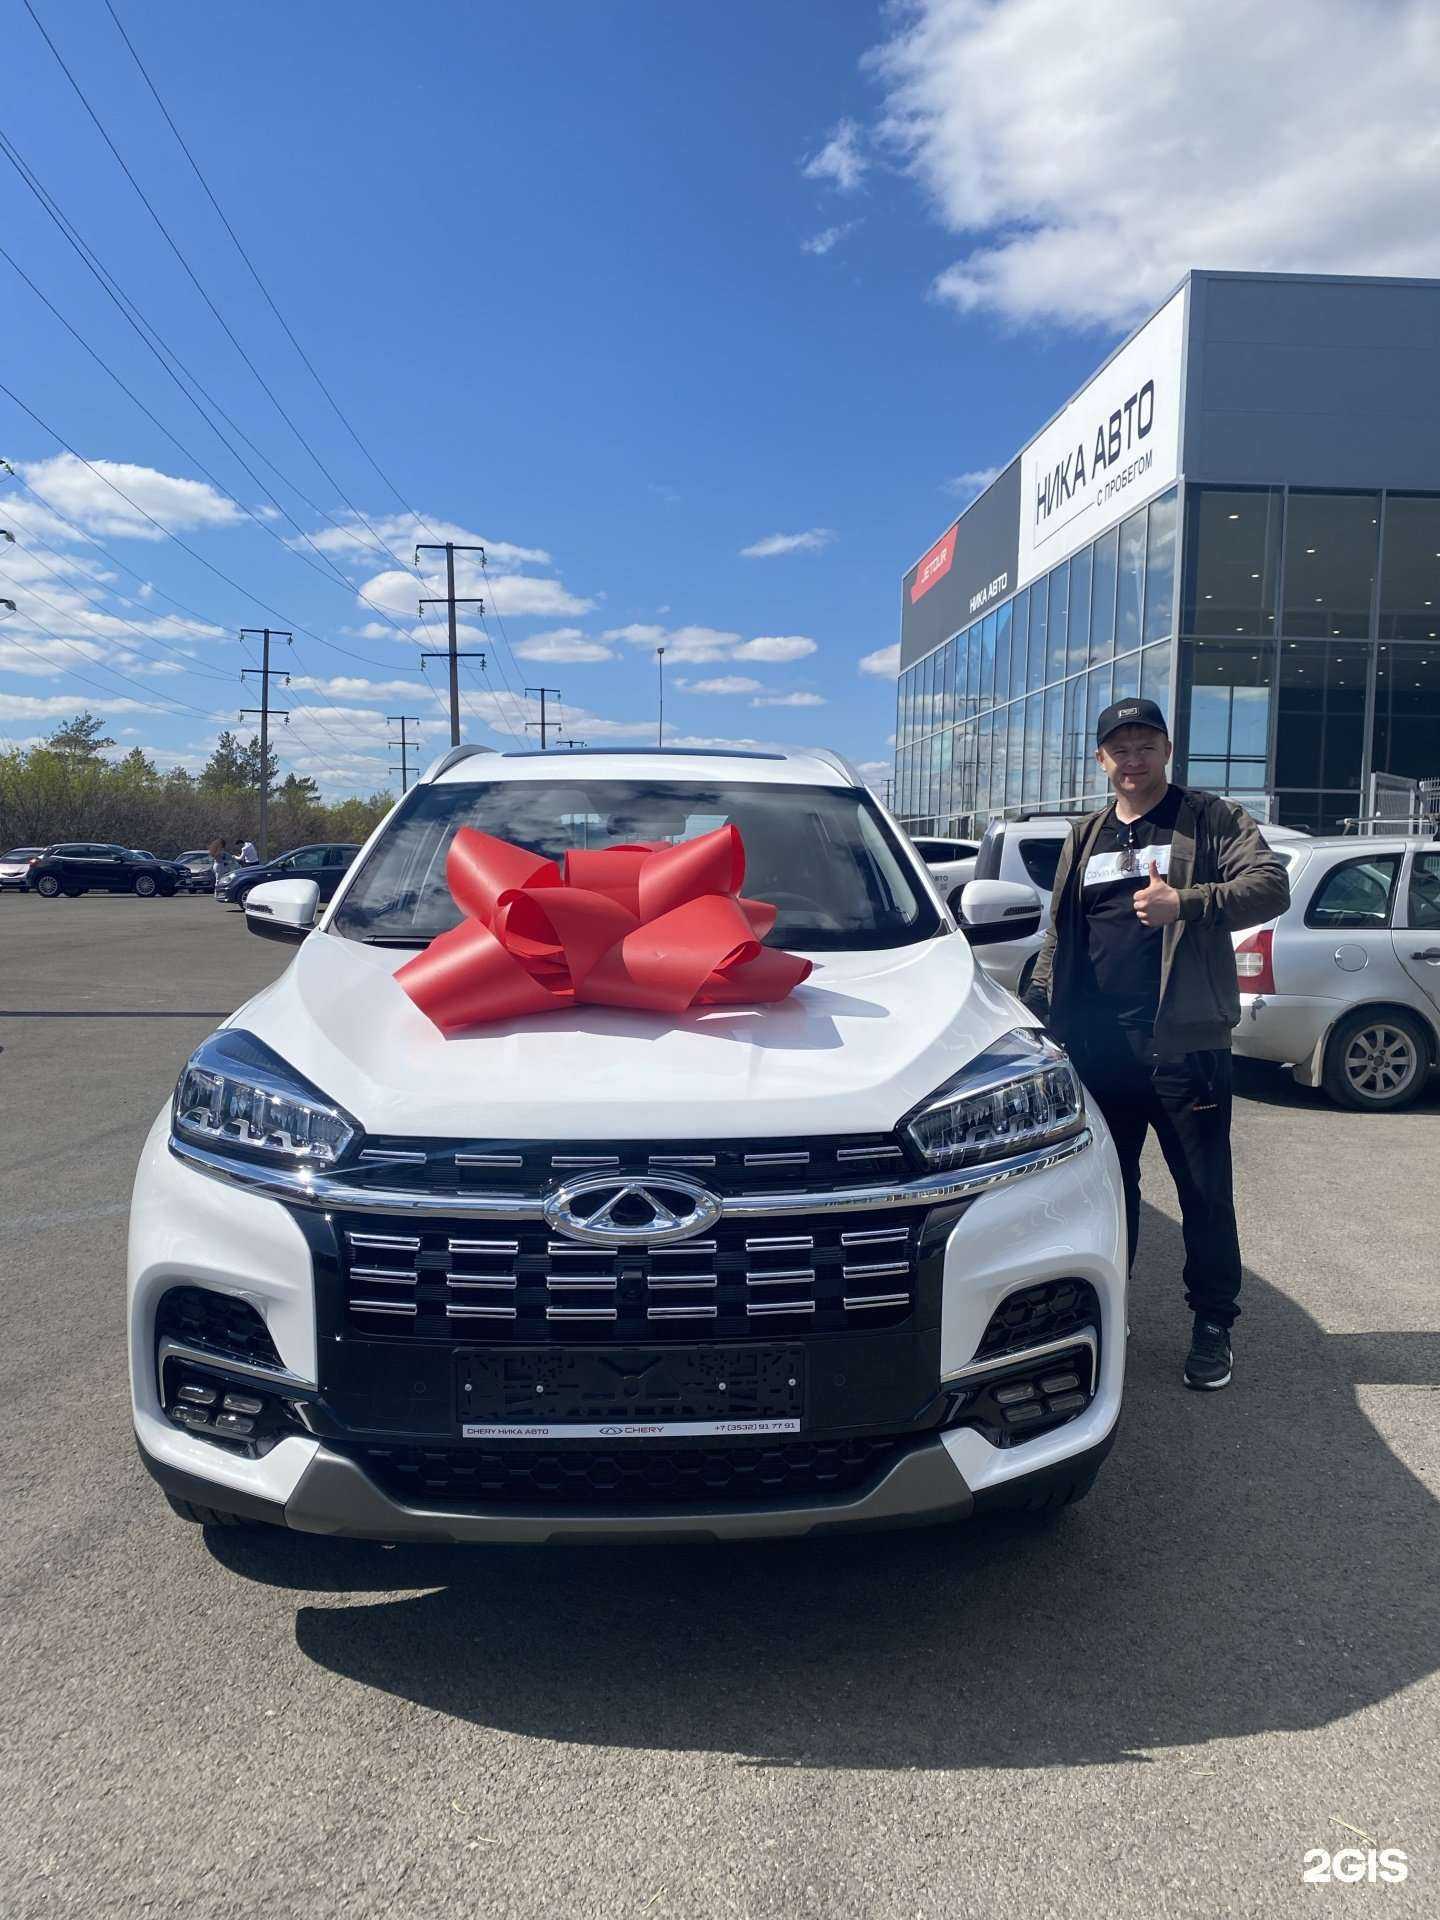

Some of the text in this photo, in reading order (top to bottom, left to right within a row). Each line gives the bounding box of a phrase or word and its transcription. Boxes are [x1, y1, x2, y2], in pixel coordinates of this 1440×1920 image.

[1036, 379, 1154, 525] НИКА АВТО
[1097, 449, 1153, 506] С ПРОБЕГОМ
[969, 572, 1008, 614] НИКА АВТО
[624, 1426, 665, 1434] CHERY
